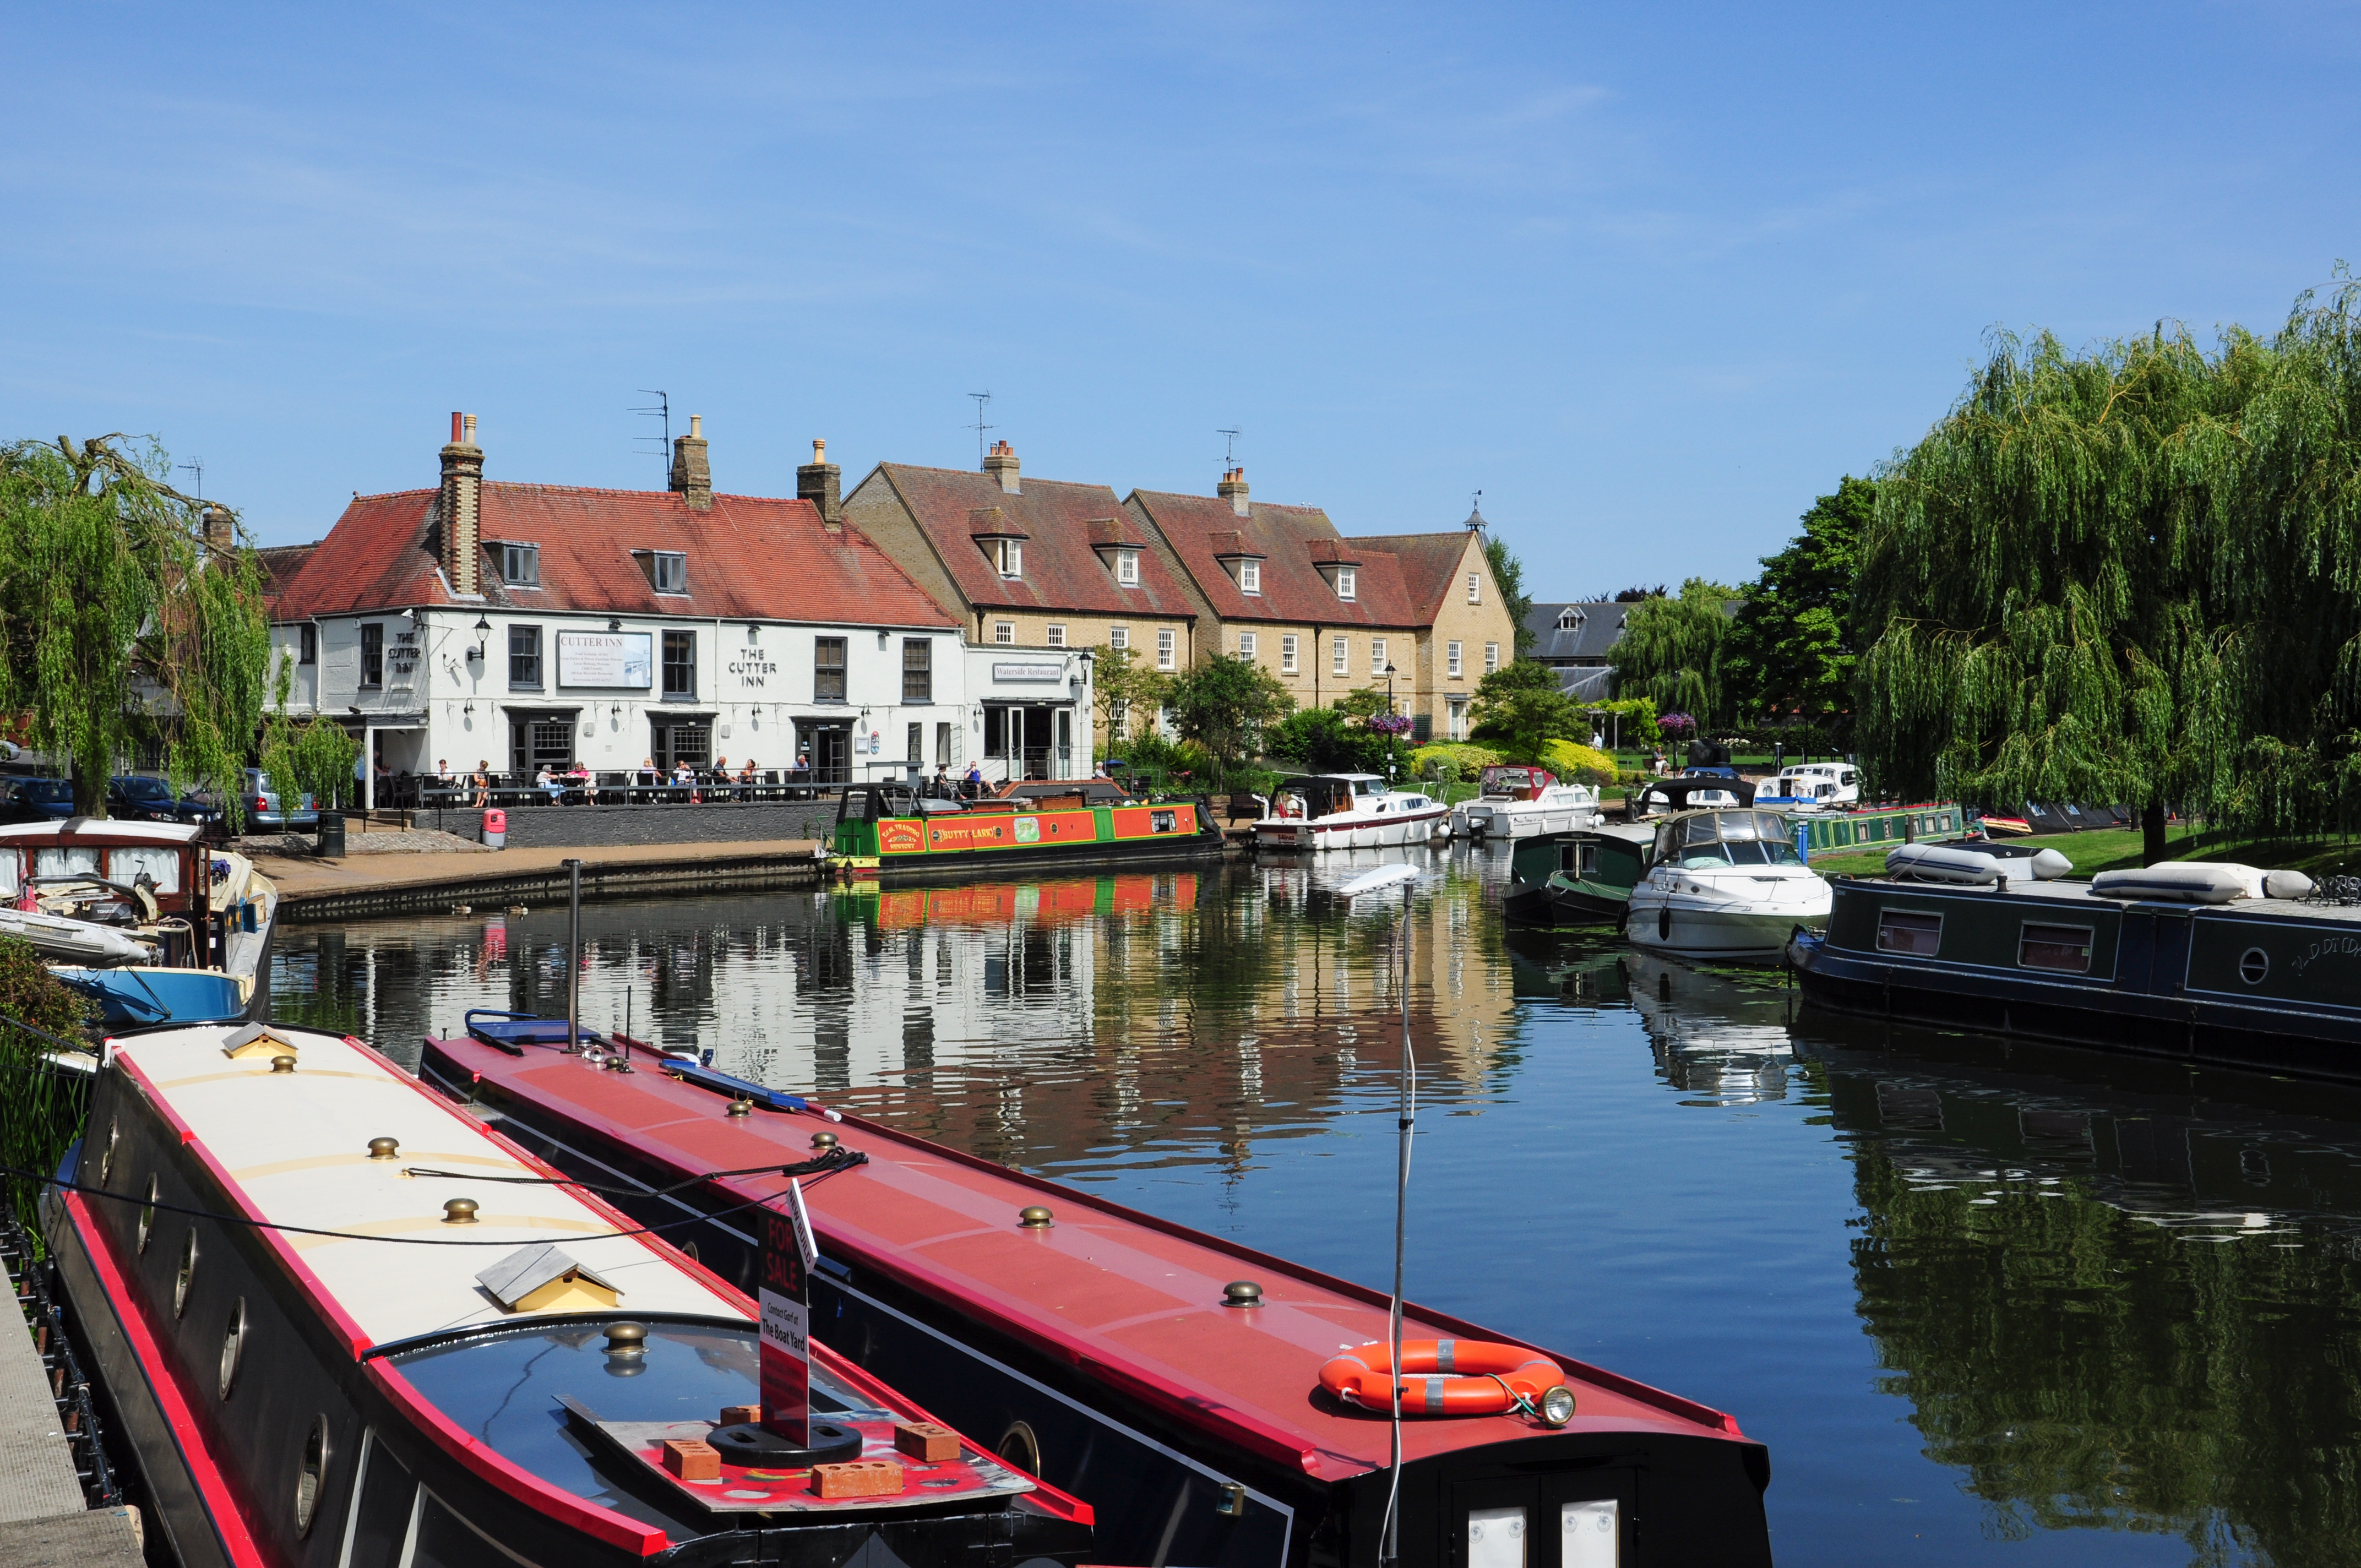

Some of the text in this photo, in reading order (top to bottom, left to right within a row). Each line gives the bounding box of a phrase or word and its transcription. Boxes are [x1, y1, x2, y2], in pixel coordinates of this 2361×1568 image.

[396, 633, 415, 644] THE
[561, 636, 623, 647] CUTTER INN
[388, 647, 421, 658] CUTTER
[741, 649, 764, 661] THE
[396, 662, 414, 673] INN
[728, 662, 777, 674] CUTTER
[742, 676, 764, 688] INN
[943, 829, 969, 840] BUTTY
[788, 1190, 812, 1265] NEW BUILD
[769, 1217, 794, 1255] FOR
[767, 1251, 798, 1292] SALE
[768, 1302, 783, 1319] Contact
[793, 1315, 798, 1326] at
[762, 1317, 805, 1352] The Boat Yard
